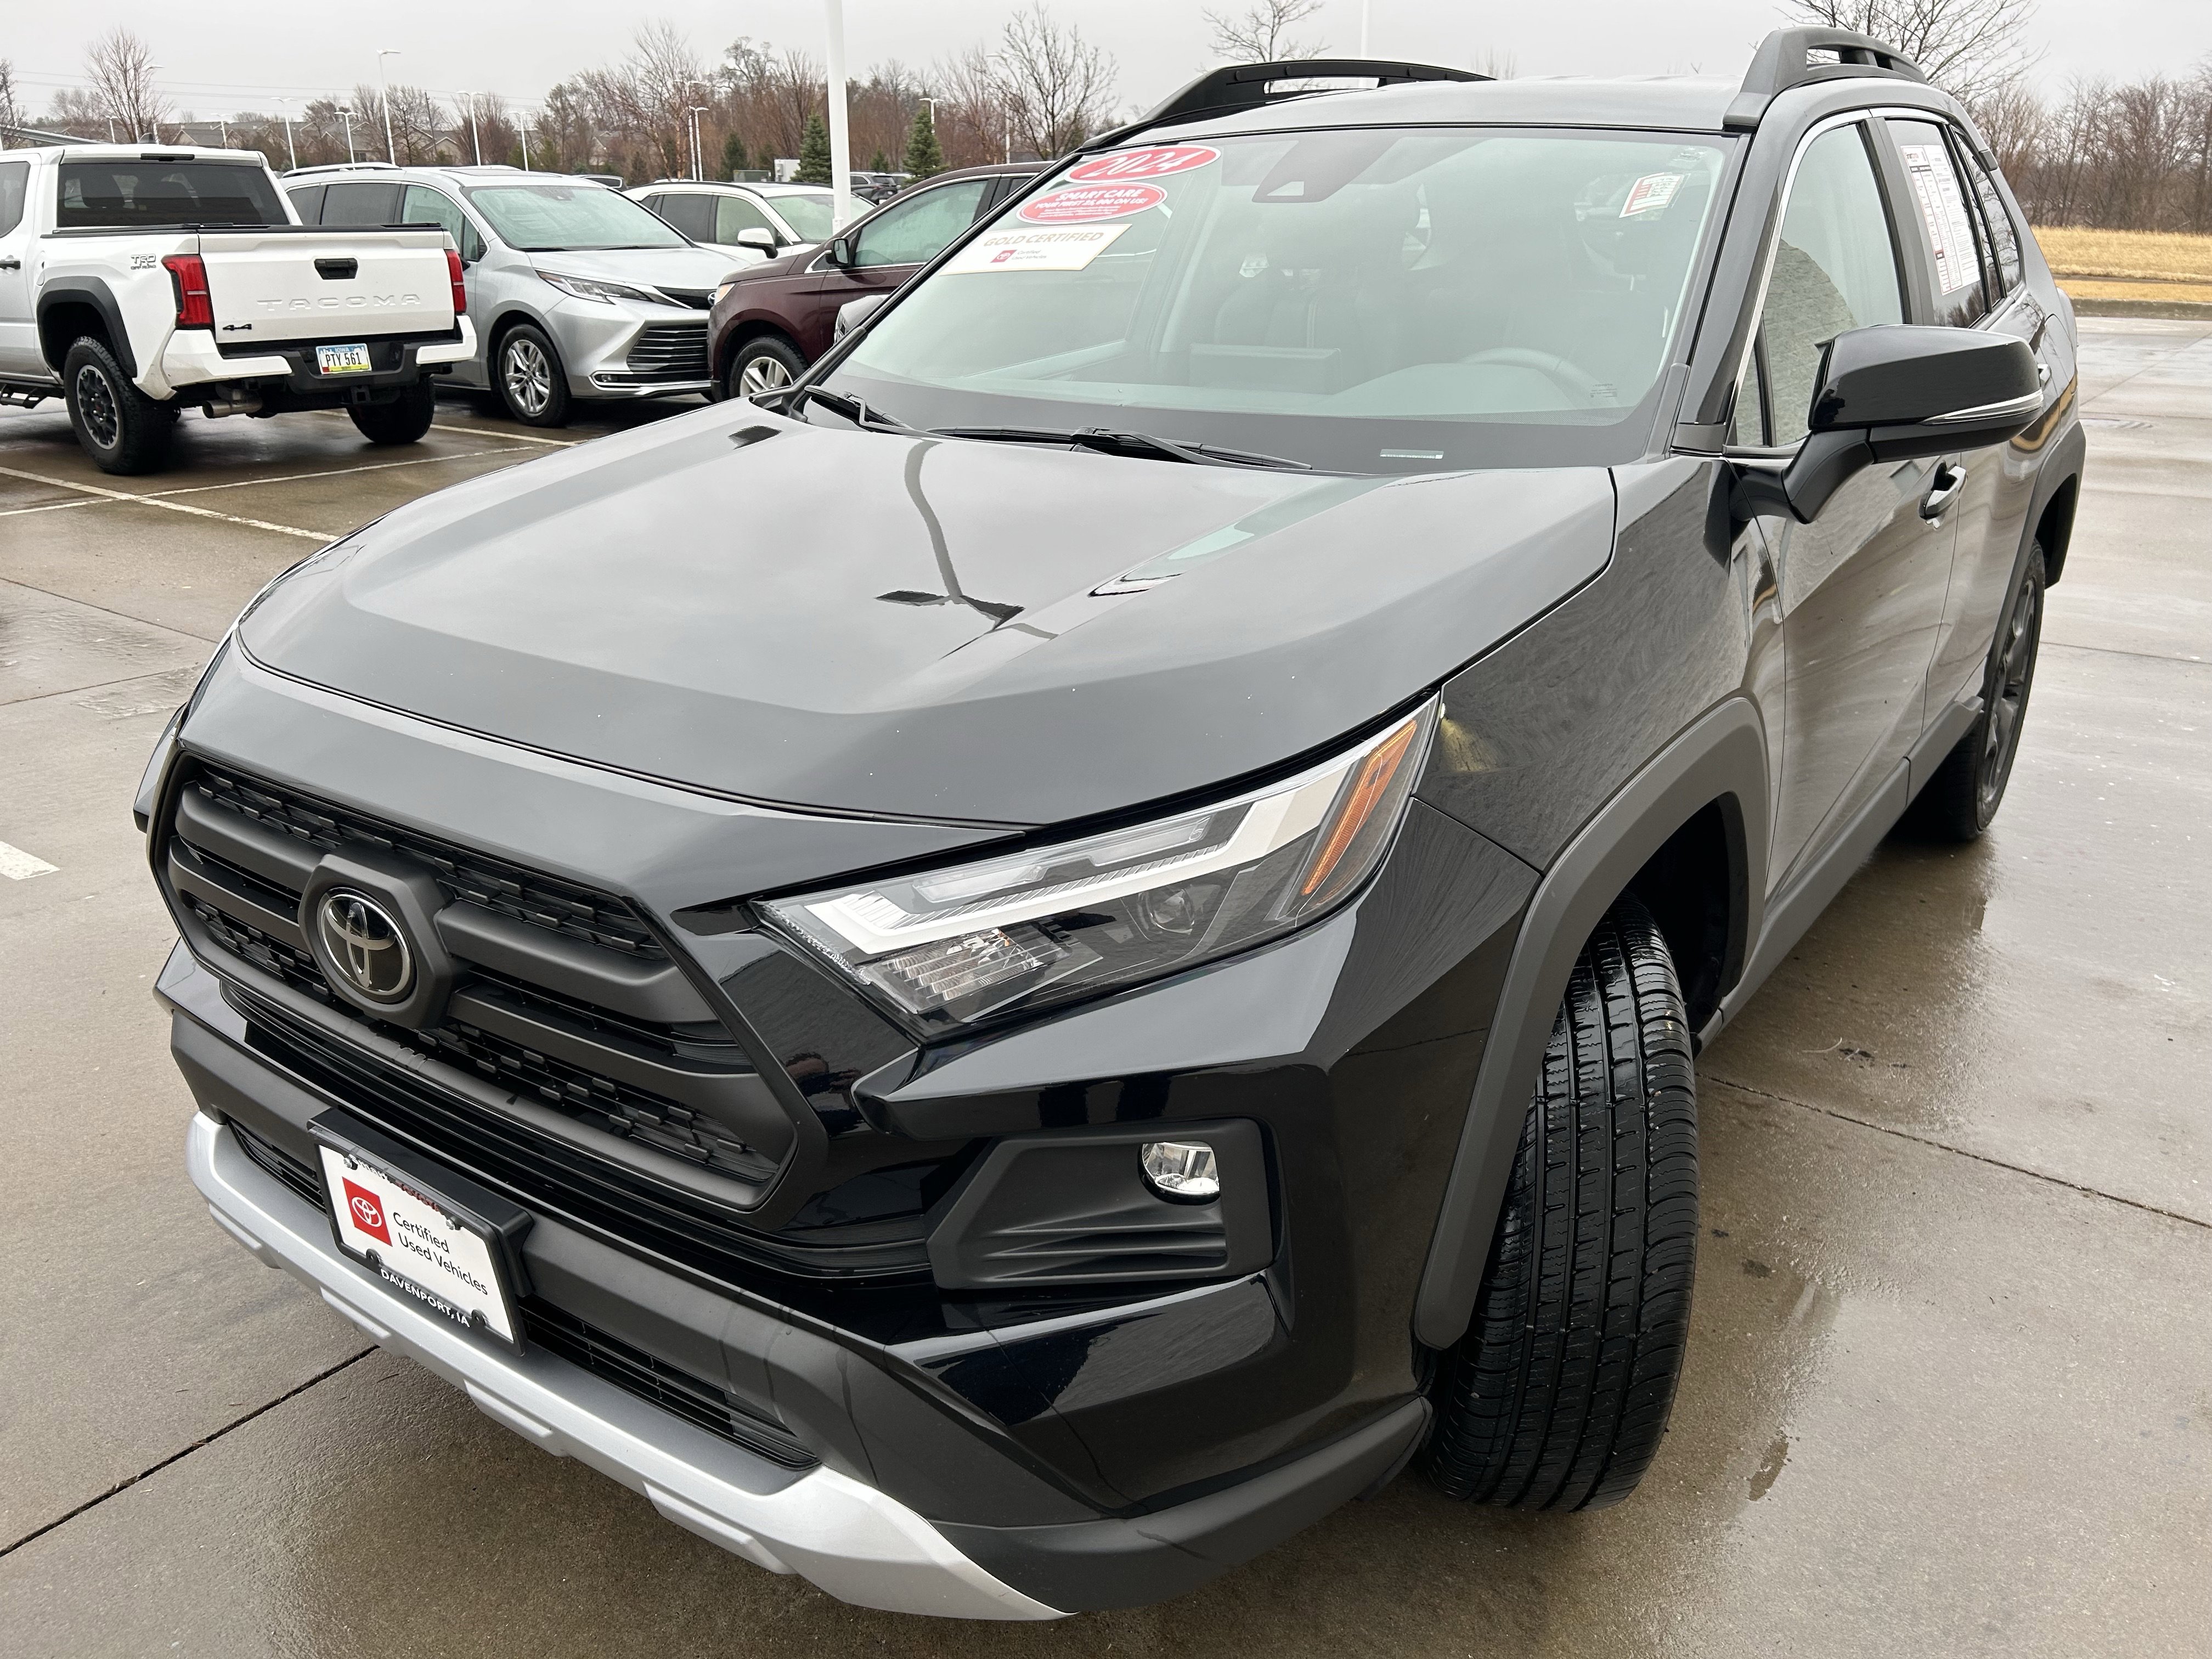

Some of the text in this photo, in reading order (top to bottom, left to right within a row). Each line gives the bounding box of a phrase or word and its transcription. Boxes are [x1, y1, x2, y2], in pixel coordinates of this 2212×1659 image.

[1080, 150, 1206, 178] 2024
[1056, 189, 1146, 202] SMART CARE
[1035, 201, 1060, 209] YOUR
[983, 232, 1104, 247] GOLD CERTIFIED
[131, 253, 156, 267] TRD
[256, 294, 421, 312] TACOMA
[325, 352, 362, 366] PTY 561
[393, 1212, 450, 1254] Certified
[398, 1232, 488, 1295] Used Vehicles
[456, 1312, 470, 1328] IA
